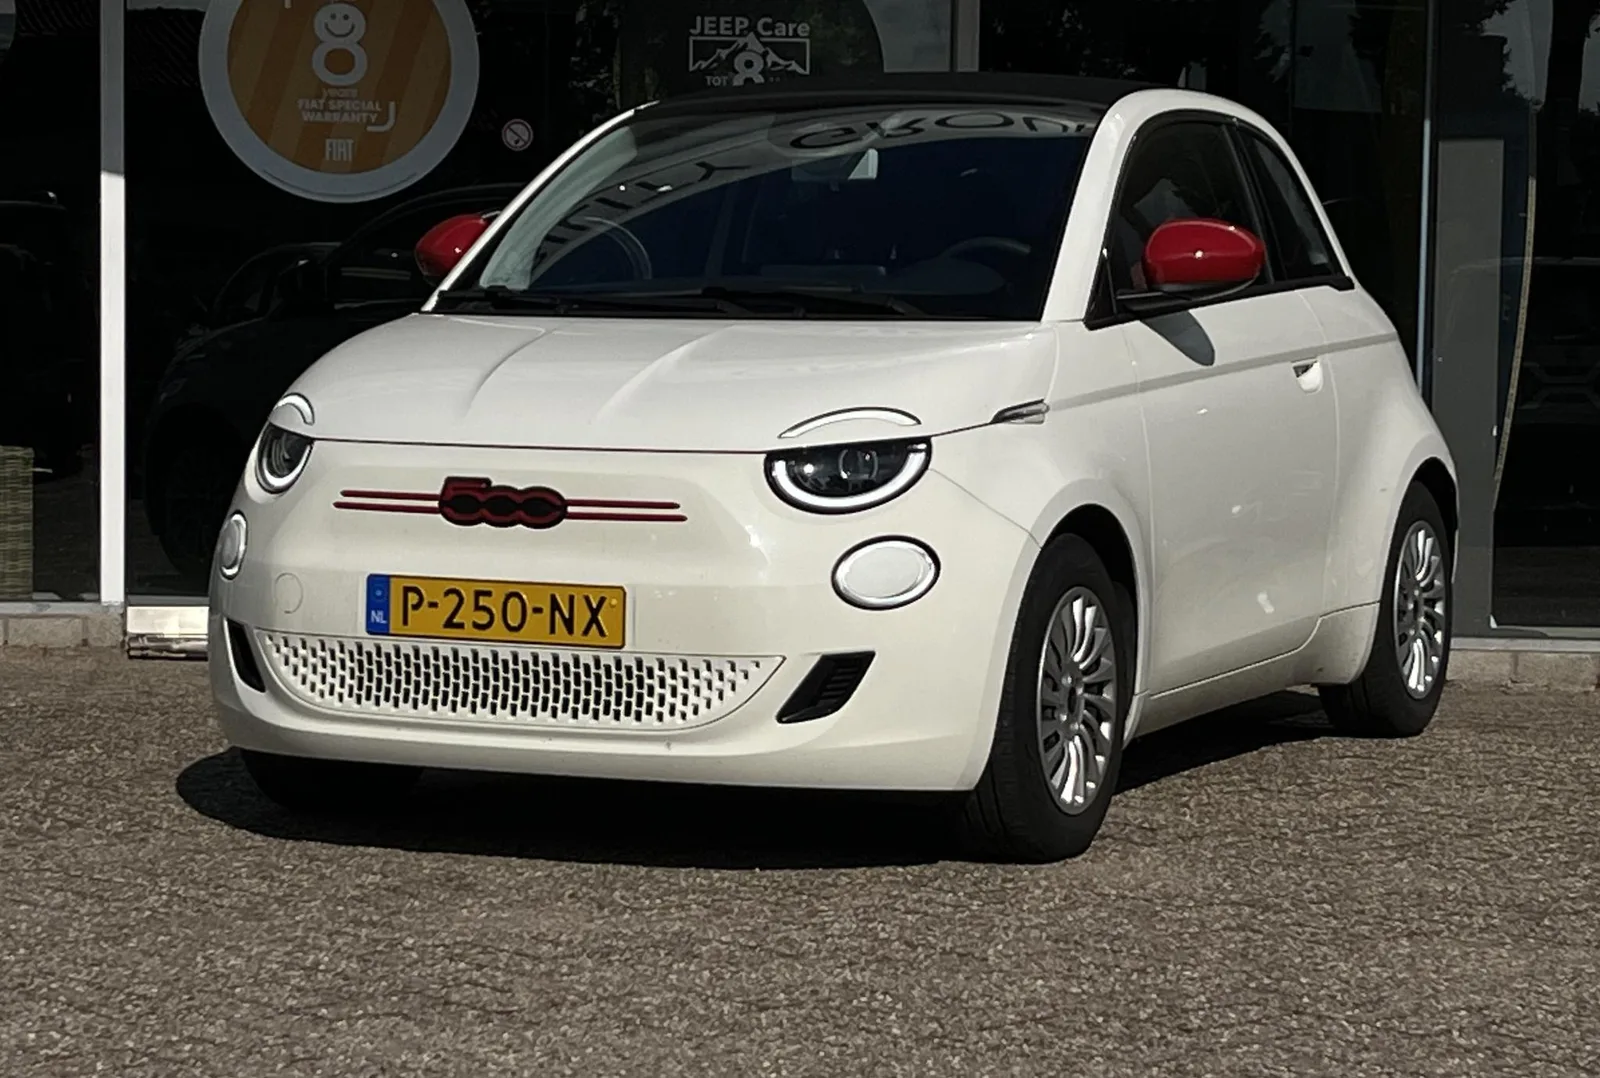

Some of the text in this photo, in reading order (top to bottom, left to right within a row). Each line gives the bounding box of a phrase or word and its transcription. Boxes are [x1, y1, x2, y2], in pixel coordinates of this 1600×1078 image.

[757, 16, 811, 37] Care
[312, 2, 368, 87] 8
[704, 75, 729, 87] TOT
[297, 98, 382, 112] FIAT SPECIAL
[301, 110, 379, 124] WARRANTY
[325, 138, 354, 162] FIAT
[439, 476, 568, 529] 500
[370, 609, 388, 625] NL
[402, 585, 608, 638] P-250-NX
